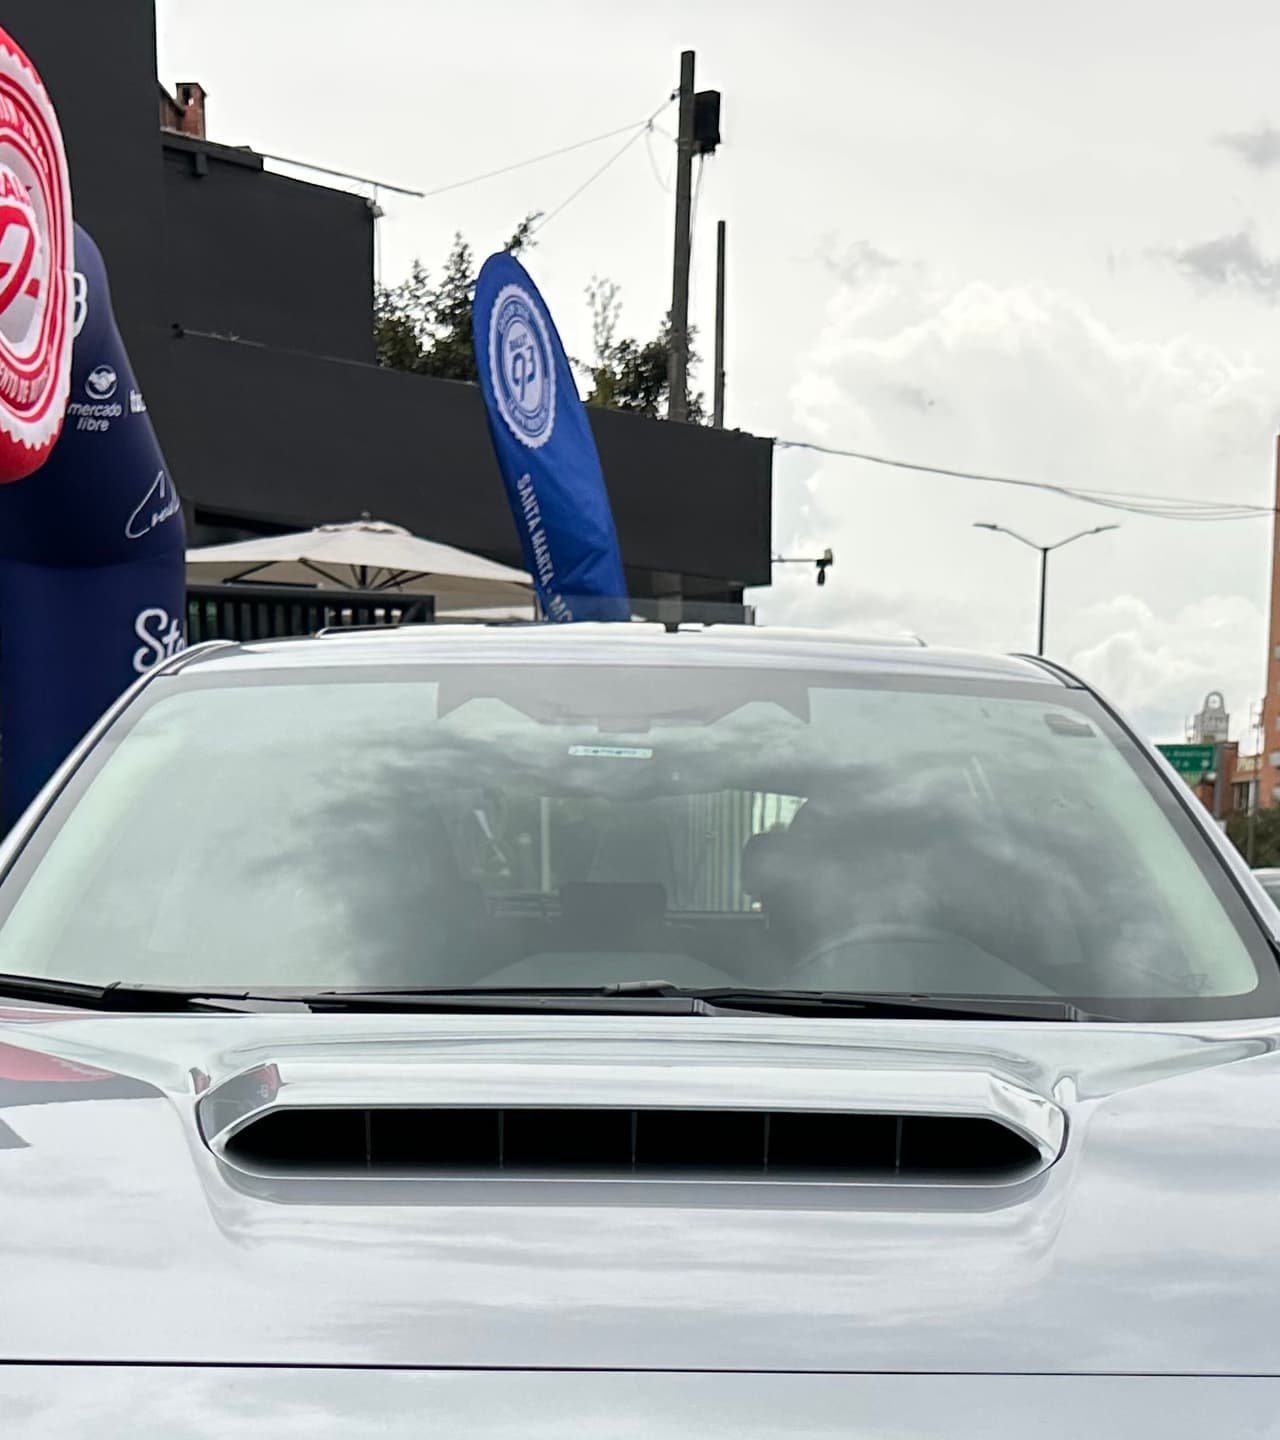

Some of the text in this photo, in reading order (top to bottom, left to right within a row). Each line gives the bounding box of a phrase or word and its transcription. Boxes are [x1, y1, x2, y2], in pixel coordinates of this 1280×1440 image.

[67, 402, 123, 417] mercado
[76, 417, 110, 432] libre
[517, 473, 542, 533] SANTA
[532, 529, 555, 587] MARTA
